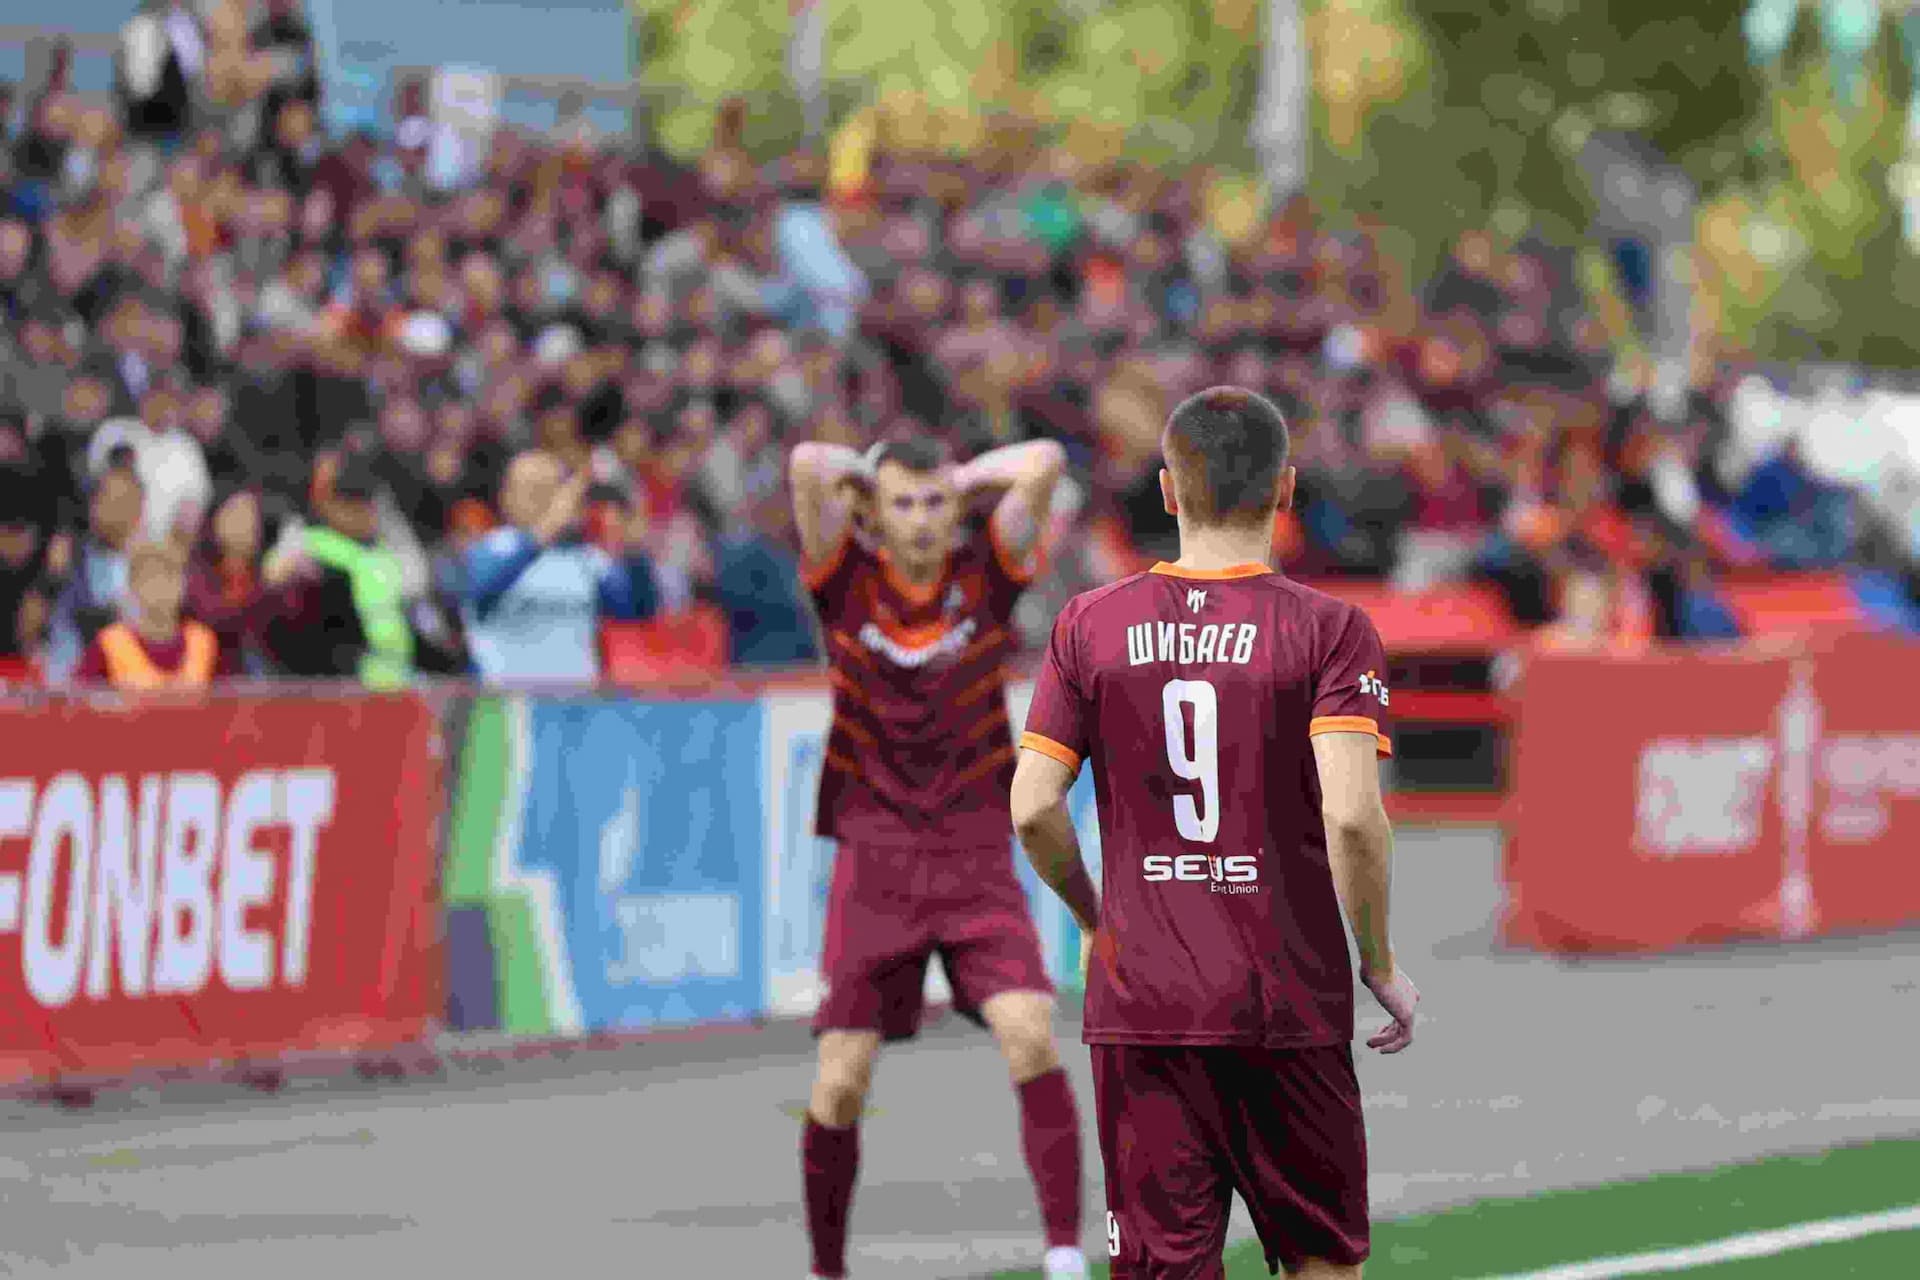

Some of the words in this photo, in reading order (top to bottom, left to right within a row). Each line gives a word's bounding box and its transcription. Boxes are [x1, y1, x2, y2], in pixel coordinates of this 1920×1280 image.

[1127, 620, 1257, 666] ШИБАЕВ
[1162, 678, 1220, 843] 9
[1228, 882, 1259, 895] Union
[1106, 1210, 1121, 1257] 9
